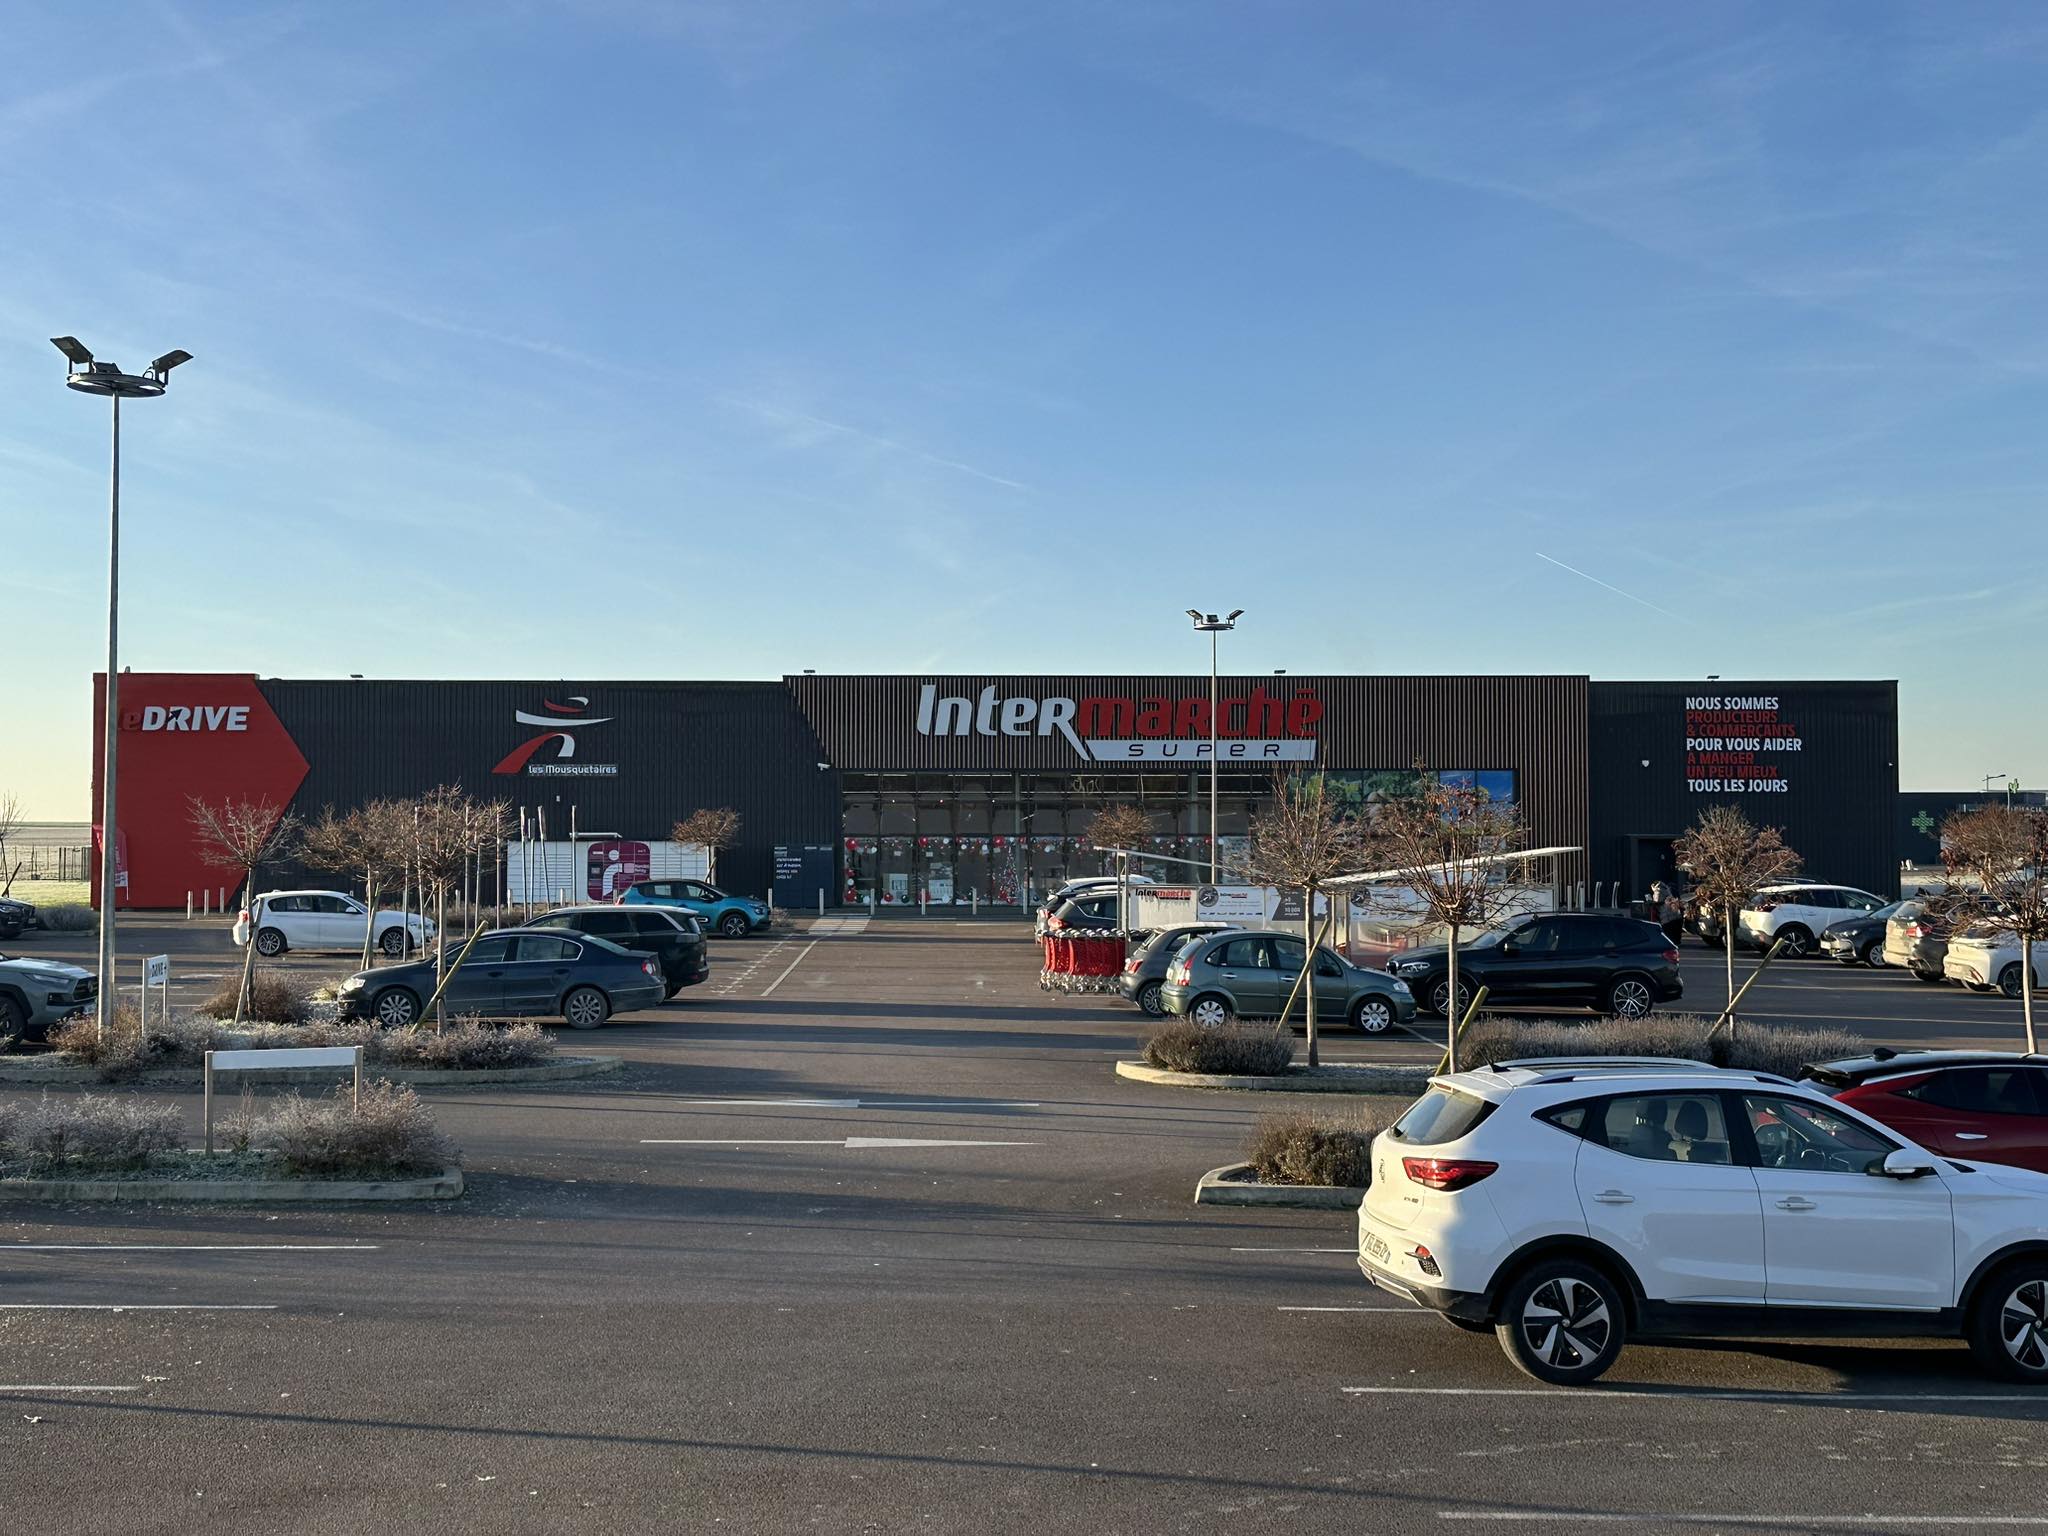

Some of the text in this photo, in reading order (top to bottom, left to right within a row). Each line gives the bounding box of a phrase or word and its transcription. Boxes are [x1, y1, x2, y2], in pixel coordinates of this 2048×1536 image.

[1686, 697, 1779, 710] NOUS SOMMES
[1686, 711, 1778, 723] PRODUCTEURS
[1686, 724, 1796, 738] & COMMERÇANTS
[1686, 738, 1802, 751] POUR VOUS AIDER
[1699, 752, 1754, 764] MANGER
[545, 765, 617, 775] Mousquetaires
[1686, 765, 1778, 778] UN PEU MIEUX
[1688, 779, 1788, 792] TOUS LES JOURS
